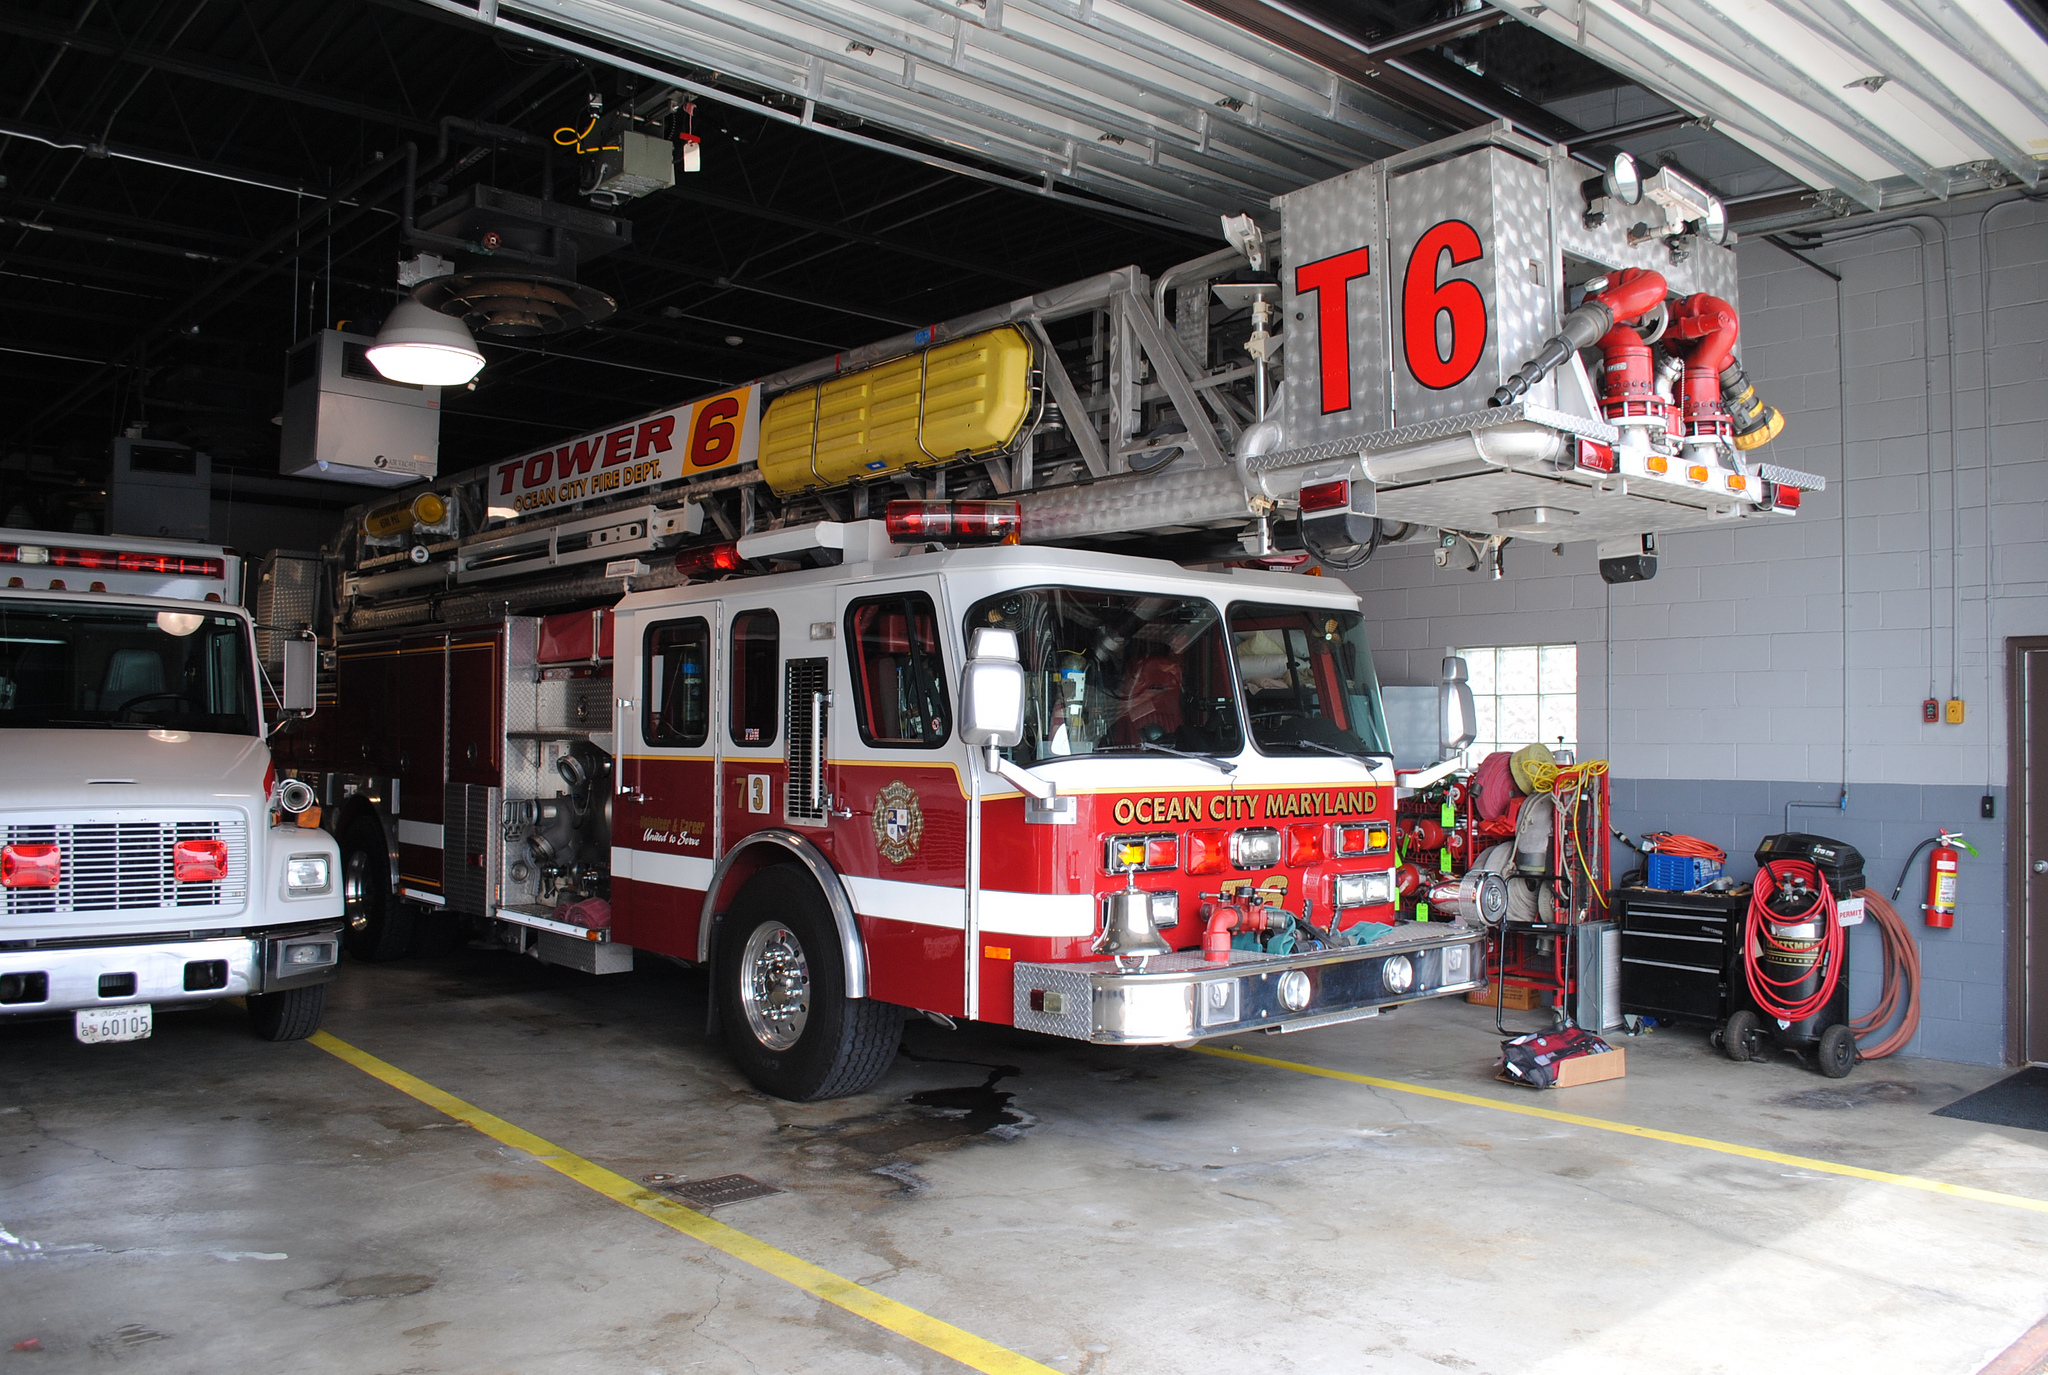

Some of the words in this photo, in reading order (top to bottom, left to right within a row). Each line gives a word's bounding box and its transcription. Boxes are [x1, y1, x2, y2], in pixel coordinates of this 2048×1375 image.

[914, 329, 931, 344] 105
[497, 415, 675, 495] TOWER
[690, 397, 740, 467] 6
[513, 486, 556, 512] OCEAN
[559, 478, 588, 501] CITY
[592, 469, 620, 494] FIRE
[623, 459, 662, 486] DEPT.
[1114, 796, 1202, 825] OCEAN
[1208, 795, 1260, 822] CITY
[1265, 791, 1377, 818] MARYLAND
[643, 828, 669, 842] United
[669, 834, 676, 843] to
[677, 831, 700, 846] Serve
[1839, 909, 1863, 918] PERMIT
[102, 1016, 149, 1036] 60105
